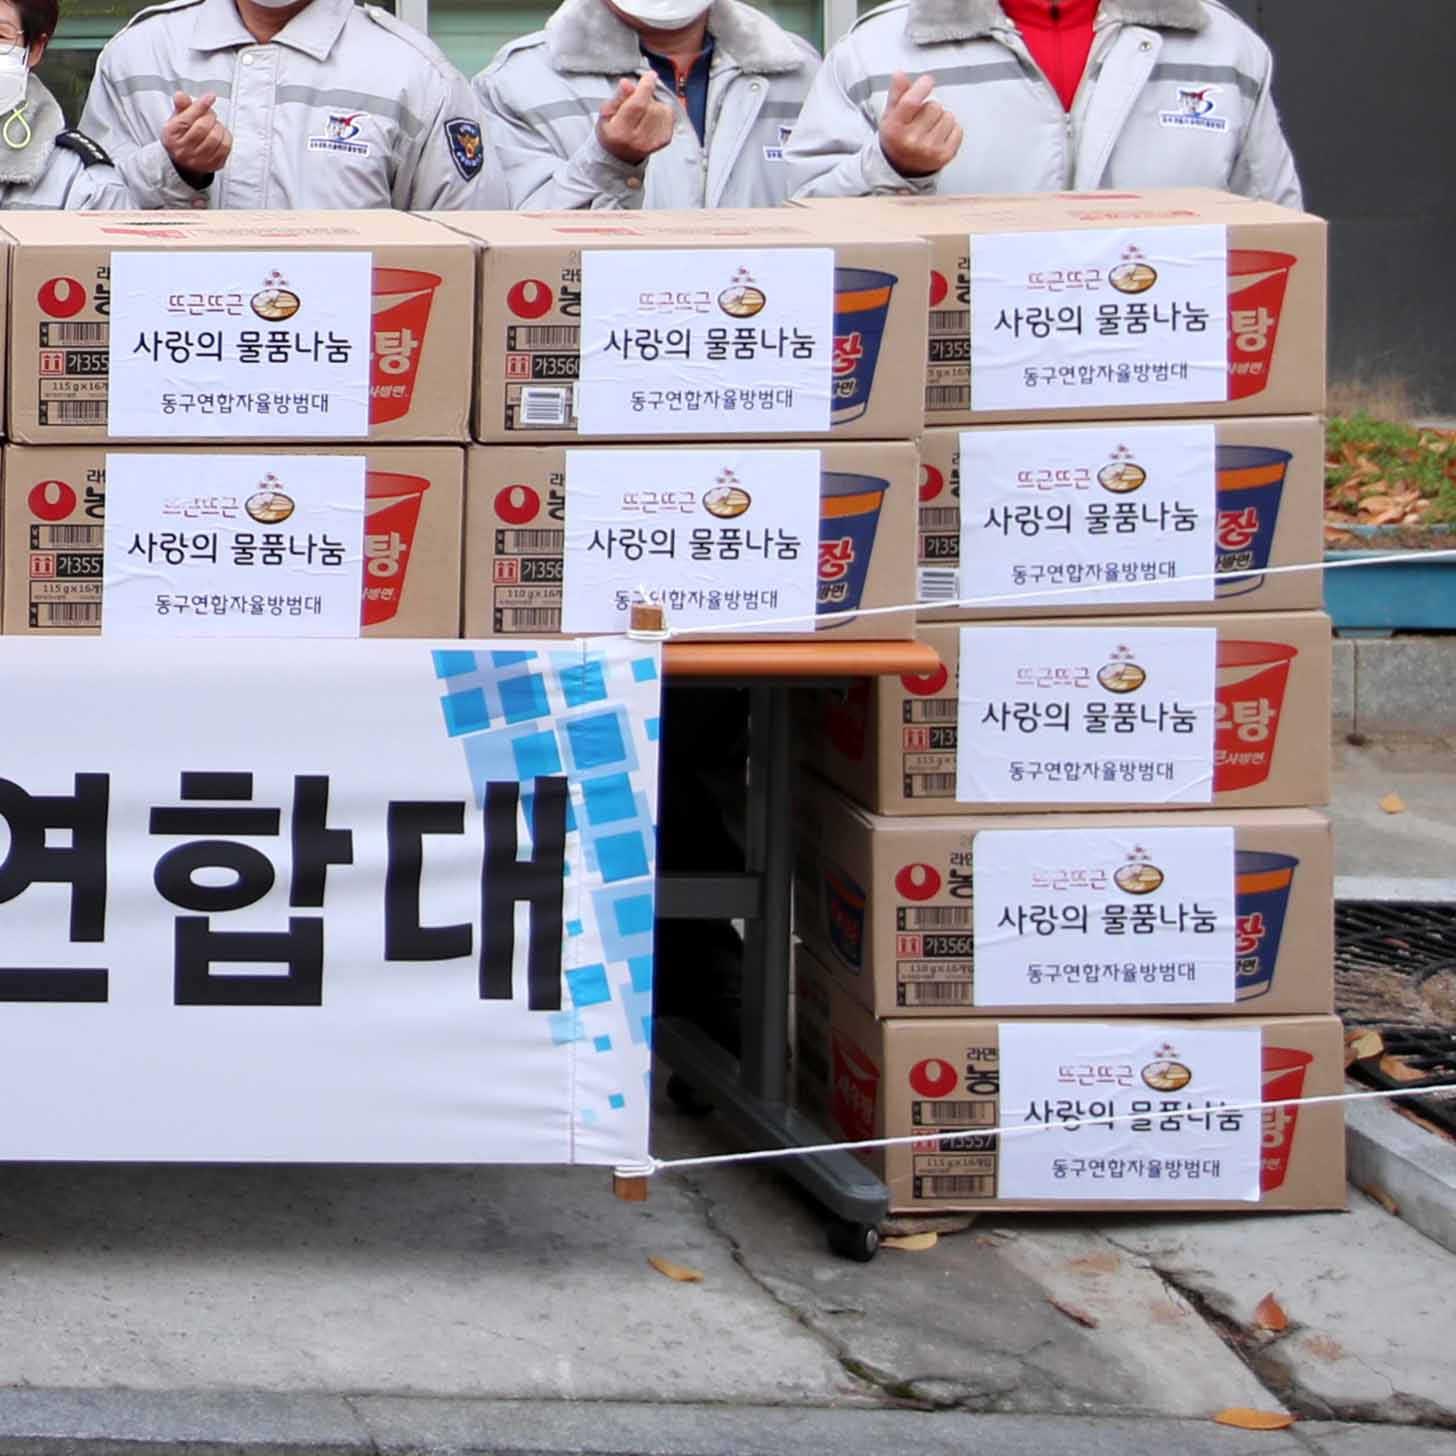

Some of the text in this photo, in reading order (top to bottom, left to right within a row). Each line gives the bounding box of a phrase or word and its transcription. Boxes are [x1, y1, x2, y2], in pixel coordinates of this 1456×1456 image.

[1025, 267, 1104, 294] 뜨근뜨근
[166, 292, 245, 318] 뜨근뜨근
[993, 300, 1210, 340] 사랑의 물품나눔
[131, 329, 354, 365] 사랑의 물품나눔
[602, 326, 817, 363] 사랑의 물품나눔
[932, 340, 971, 359] 가355
[67, 352, 109, 372] 가355
[535, 355, 579, 375] 가356
[1023, 361, 1189, 388] 동구연합자율방범대
[160, 391, 330, 416] 동구연합자율방범대
[629, 387, 794, 413] 동구연합자율방범대
[1016, 466, 1092, 492] 뜨근뜨근
[620, 490, 697, 515] 뜨근뜨근
[982, 499, 1200, 538] 사랑의 물품나눔
[126, 531, 347, 568] 사랑의 물품나눔
[585, 526, 802, 563] 사랑의 물품나눔
[58, 555, 103, 575] 가355
[522, 561, 563, 580] 가356
[1011, 559, 1177, 587] 동구연합자율방범대
[154, 593, 323, 617] 동구연합자율방범대
[1015, 665, 1092, 690] 뜨근뜨근
[980, 700, 1198, 735] 사랑의 물품나눔
[1008, 760, 1175, 783] 동구연합자율방범대
[1030, 868, 1109, 892] 뜨근뜨근
[996, 902, 1218, 938] 사랑의 물품나눔
[1026, 961, 1196, 986] 동구연합자율방범대
[1056, 1064, 1135, 1088] 뜨근뜨근
[1022, 1098, 1245, 1134] 사랑의 물품나눔
[1052, 1158, 1221, 1181] 동구연합자율방범대
